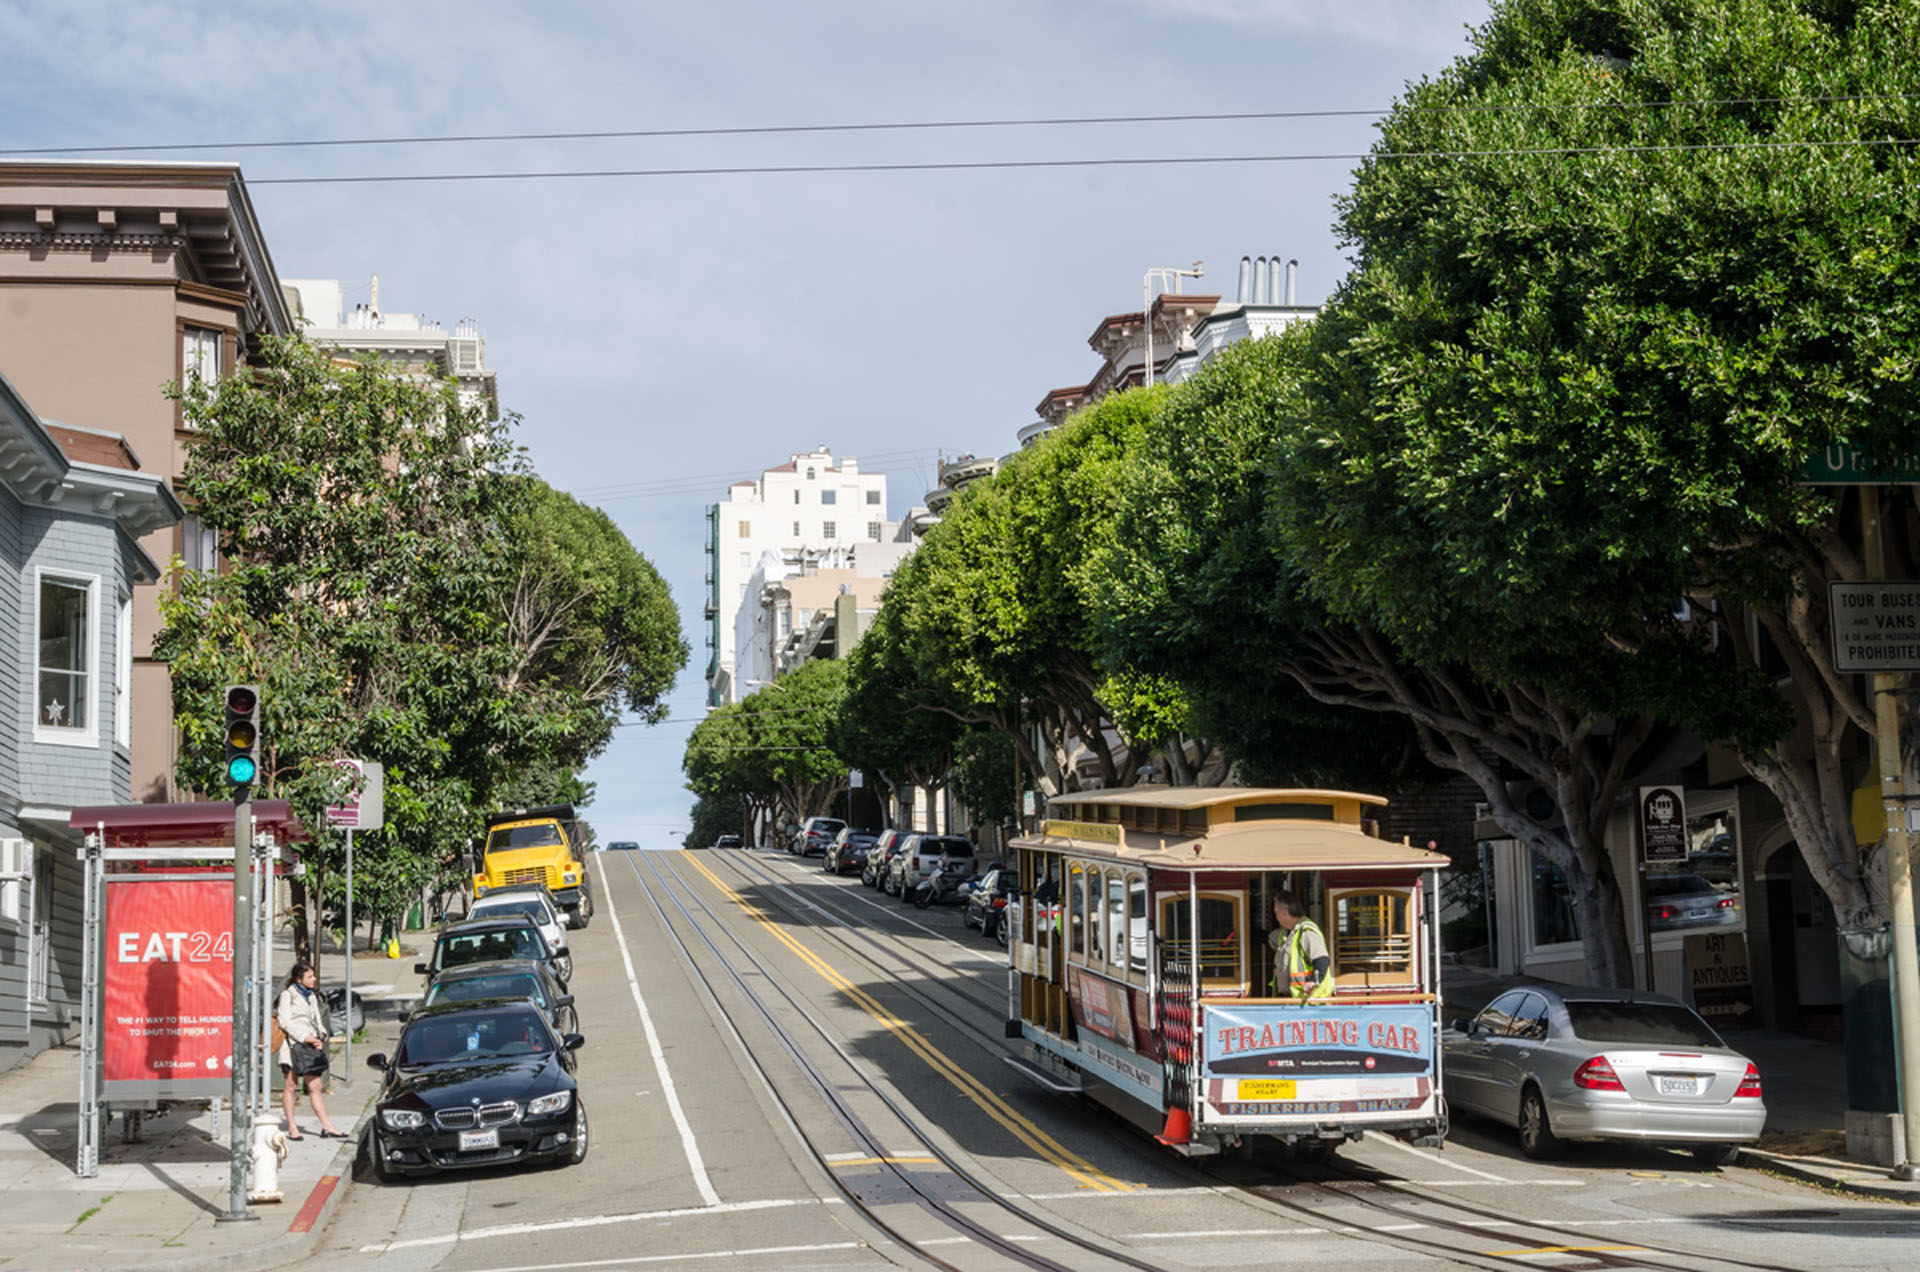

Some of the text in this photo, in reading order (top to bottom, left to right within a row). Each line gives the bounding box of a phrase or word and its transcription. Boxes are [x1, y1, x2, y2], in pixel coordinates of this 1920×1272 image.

[1841, 593, 1920, 607] TOUR BUSES
[1876, 615, 1916, 628] VANS
[118, 931, 234, 963] EAT24
[1705, 935, 1726, 953] ART
[1713, 953, 1722, 964] &
[1693, 966, 1749, 985] ANTIQUES
[117, 1016, 133, 1024] THE
[146, 1016, 163, 1024] WAY
[165, 1016, 176, 1024] TO
[130, 1028, 141, 1036] TO
[143, 1028, 164, 1036] SHUT
[166, 1028, 181, 1036] THE
[1219, 1020, 1420, 1054] TRAINING CAR
